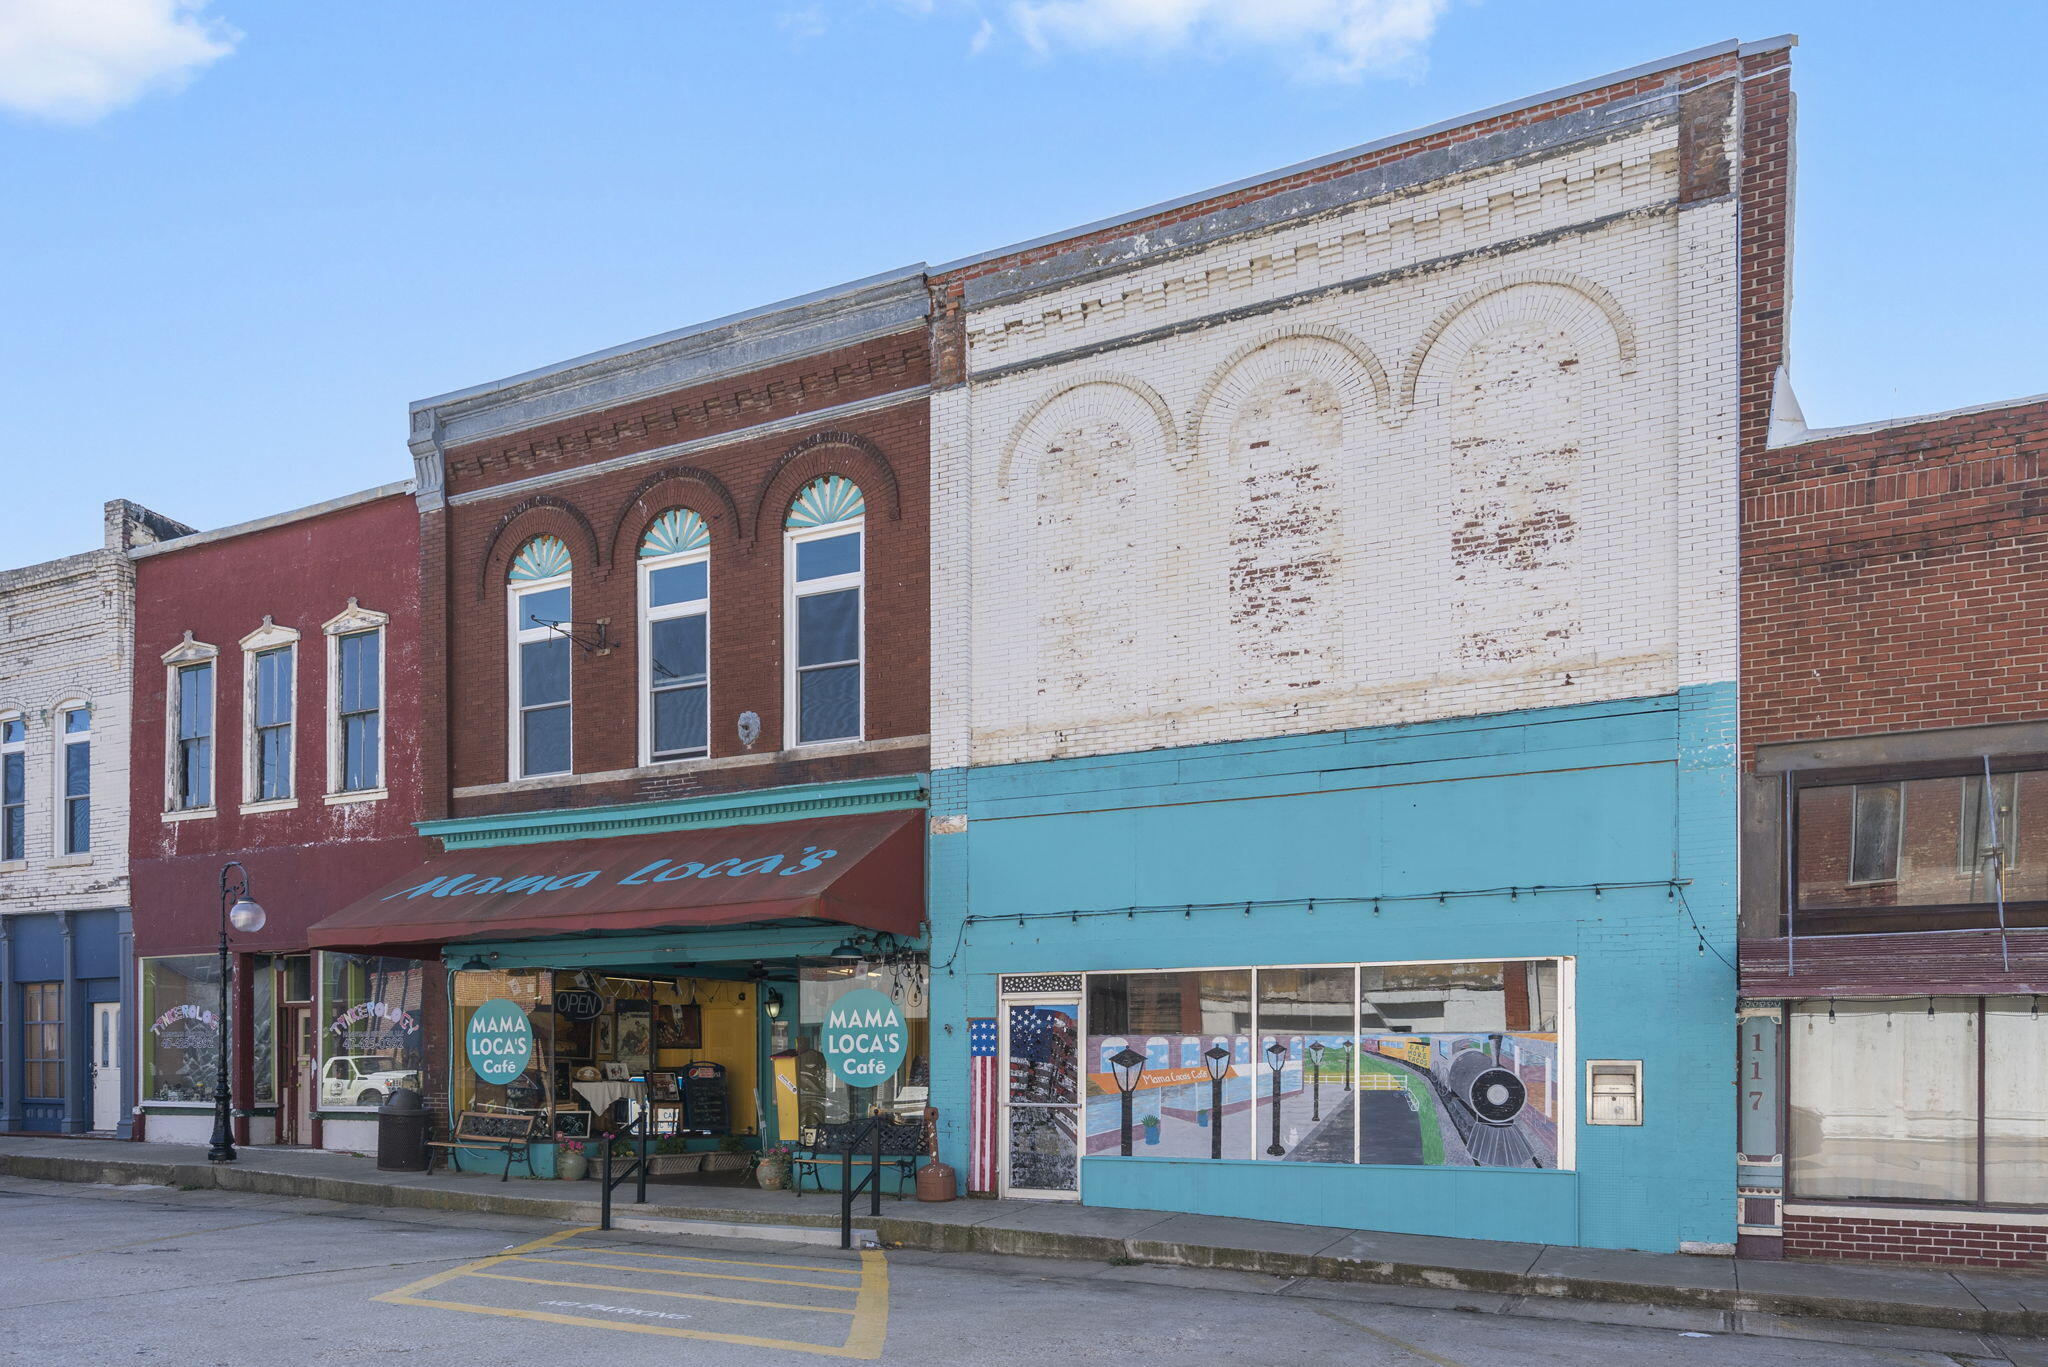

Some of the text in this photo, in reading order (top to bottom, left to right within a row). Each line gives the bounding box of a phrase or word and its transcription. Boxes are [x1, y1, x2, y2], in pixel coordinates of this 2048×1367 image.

[380, 846, 838, 901] Mama Loca's
[557, 993, 598, 1014] OPEN
[150, 1004, 221, 1036] TYNKEROLOG
[472, 1016, 526, 1034] MAMA
[829, 1008, 899, 1029] MAMA
[472, 1037, 527, 1055] LOCA'S
[829, 1033, 900, 1055] LOCA'S
[483, 1060, 516, 1073] Café
[843, 1059, 886, 1074] Café
[1748, 1033, 1765, 1111] 117
[1142, 1074, 1171, 1085] Mama
[578, 1303, 692, 1320] PARKING
